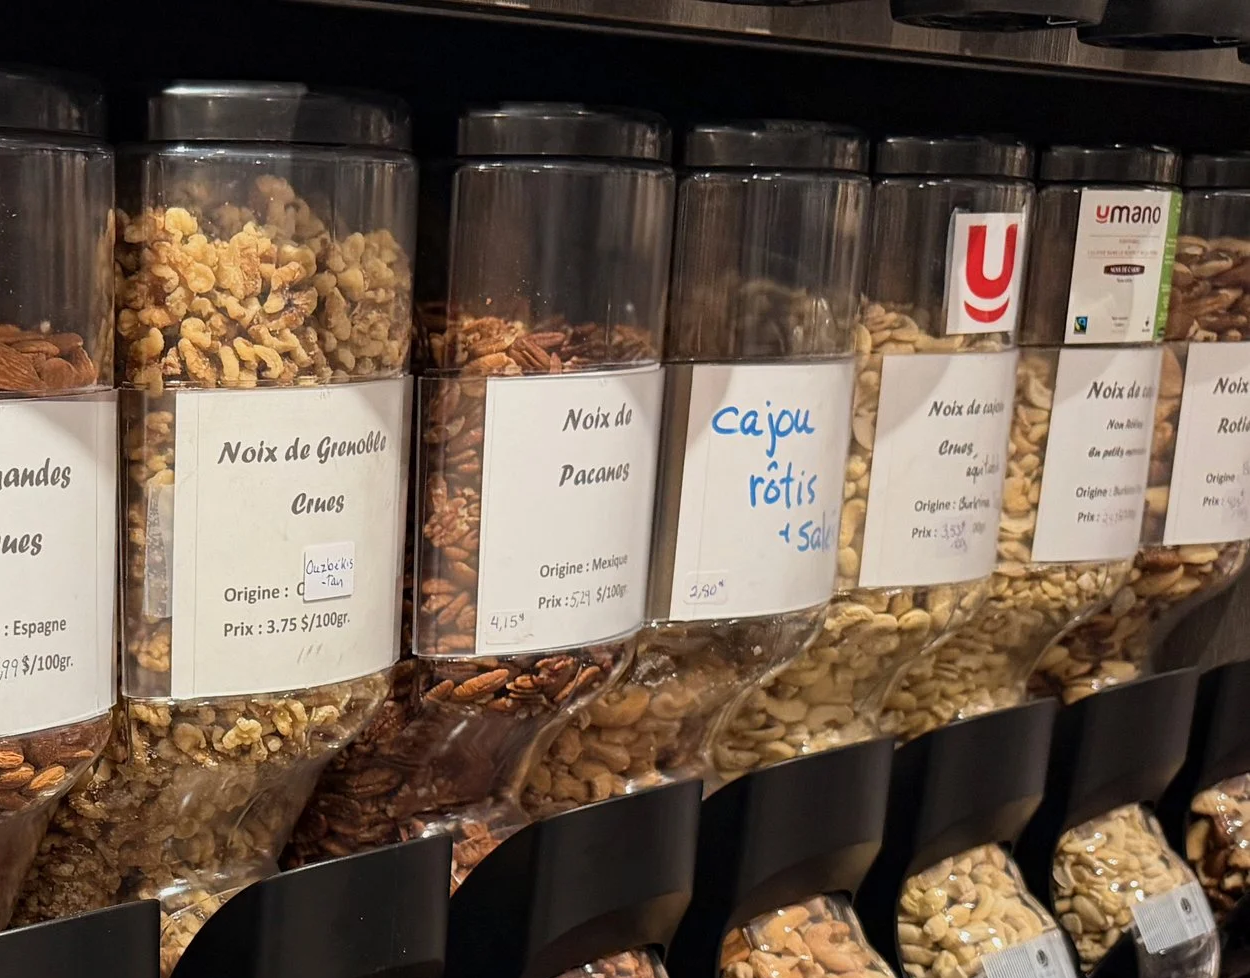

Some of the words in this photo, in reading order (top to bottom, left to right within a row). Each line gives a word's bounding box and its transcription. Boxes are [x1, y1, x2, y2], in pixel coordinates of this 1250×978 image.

[1096, 205, 1161, 224] umano
[1086, 381, 1124, 399] Noix
[1127, 380, 1140, 399] de
[1213, 377, 1249, 395] Noix
[562, 406, 611, 432] Noix
[615, 403, 632, 426] de
[928, 400, 963, 416] Noix
[967, 399, 981, 415] de
[711, 401, 815, 457] cajou
[217, 440, 278, 465] Noix
[285, 438, 311, 461] de
[317, 430, 387, 464] Grenoble
[559, 461, 630, 487] Pacanes
[1206, 472, 1235, 485] Origine
[750, 461, 817, 509] rôtis
[1076, 486, 1107, 500] Origine
[291, 493, 345, 515] Crues
[914, 499, 950, 513] Origine
[1078, 511, 1095, 523] Prix
[912, 527, 931, 538] Prix
[540, 562, 584, 579] Origine
[592, 554, 628, 571] Mexique
[224, 584, 280, 604] Origine
[538, 595, 562, 609] Prix
[12, 617, 67, 639] Espagne
[223, 622, 253, 637] Prix
[267, 617, 297, 634] 3.75
[301, 610, 350, 634] $/100gr.
[22, 653, 74, 676] $/100gr.
